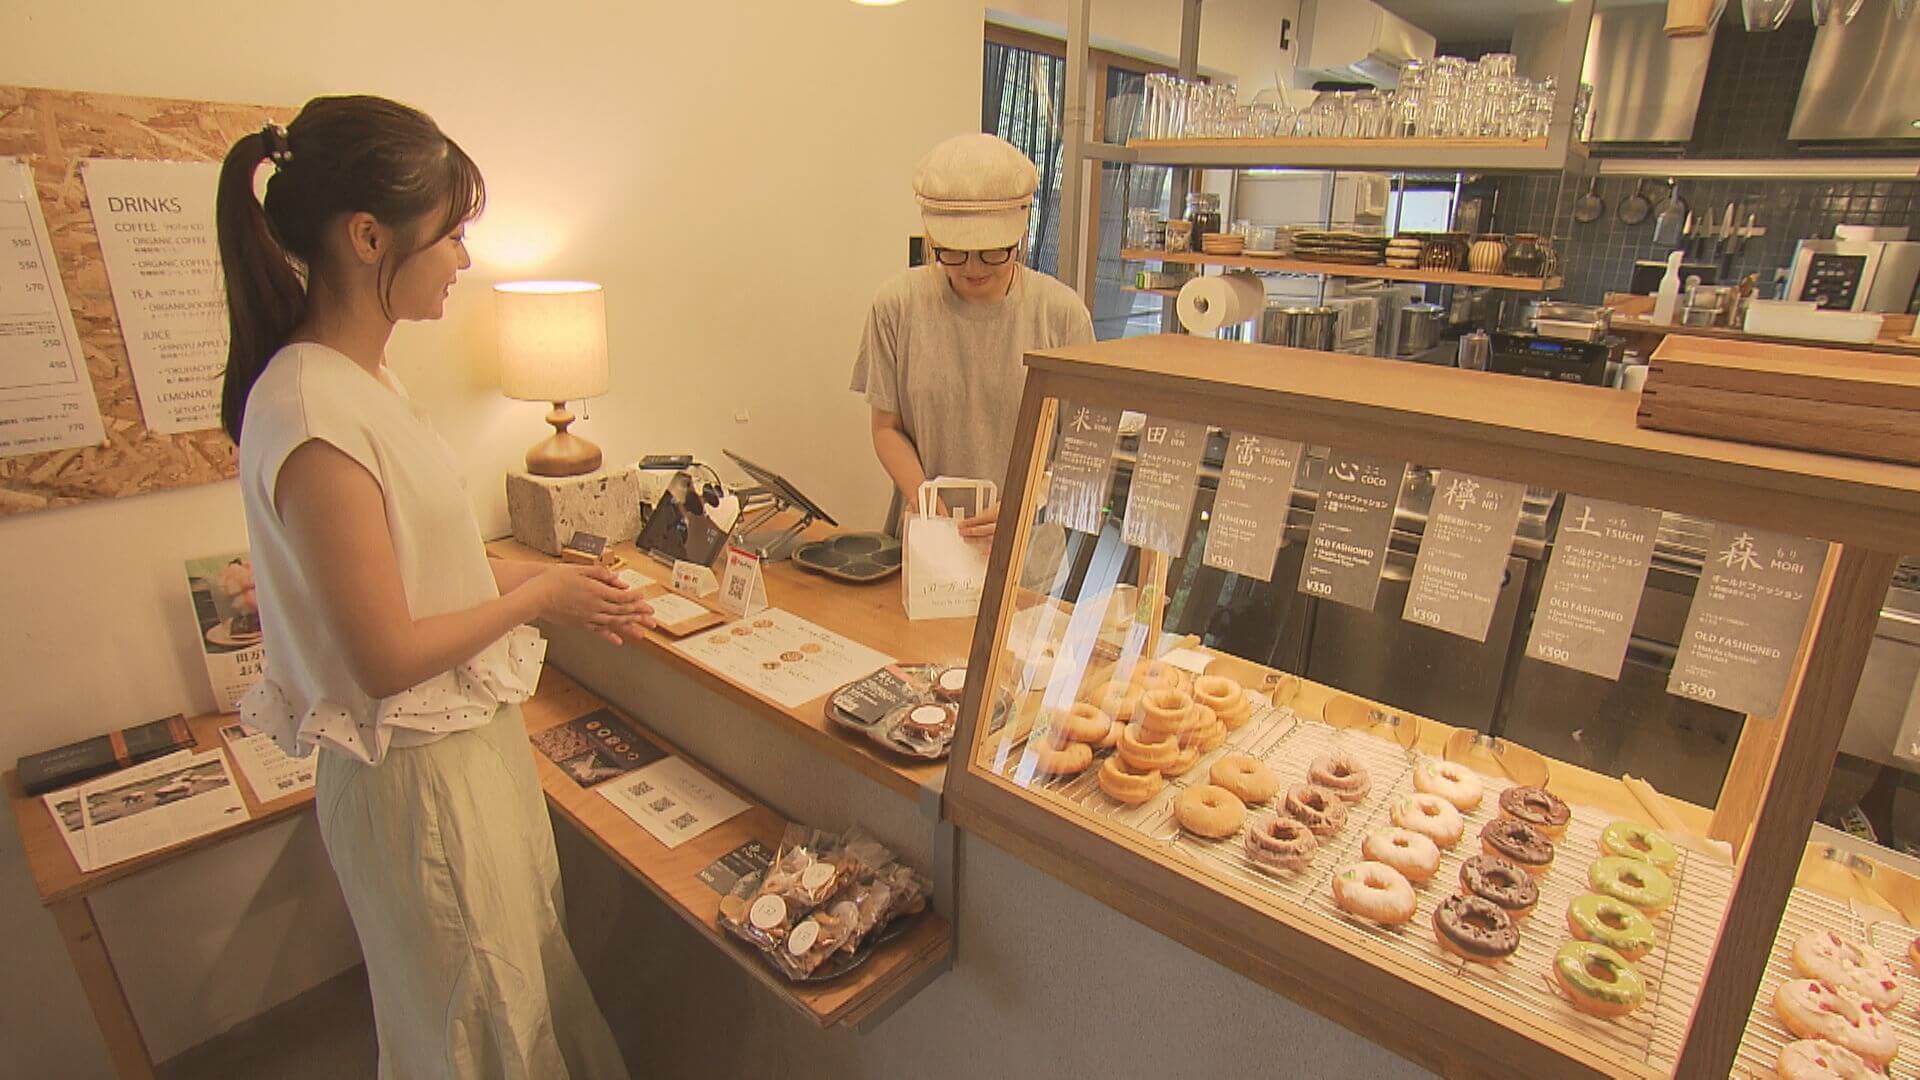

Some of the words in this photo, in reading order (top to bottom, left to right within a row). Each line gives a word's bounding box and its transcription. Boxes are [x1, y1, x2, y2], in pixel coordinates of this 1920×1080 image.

[108, 196, 182, 213] DRINKS
[114, 223, 158, 232] COFFEE
[132, 290, 154, 299] TEA
[143, 331, 171, 340] JUICE
[62, 403, 80, 411] 770
[1070, 407, 1091, 433] 米
[1147, 426, 1168, 444] 田
[1361, 474, 1387, 487] COCO
[1326, 490, 1389, 508] オールドファッション
[1481, 500, 1498, 511] NEI
[1218, 512, 1258, 528] FERMENTED
[1564, 505, 1601, 537] 土
[1605, 527, 1645, 544] TSUCHI
[1314, 537, 1330, 548] OLD
[1331, 541, 1374, 558] FASHIONED
[1564, 544, 1642, 567] オールドファッション
[1717, 532, 1764, 571] 森
[1423, 563, 1468, 581] FERMENTED
[1770, 559, 1804, 574] MORI
[1712, 575, 1803, 600] オールドファッション
[1413, 606, 1441, 624] ¥390
[1550, 597, 1570, 610] OLD
[1570, 602, 1623, 622] FASHIONED
[1539, 644, 1569, 662] ¥390
[1694, 631, 1717, 643] OLD
[1718, 636, 1781, 659] FASHIONED
[1680, 681, 1717, 700] ¥390
